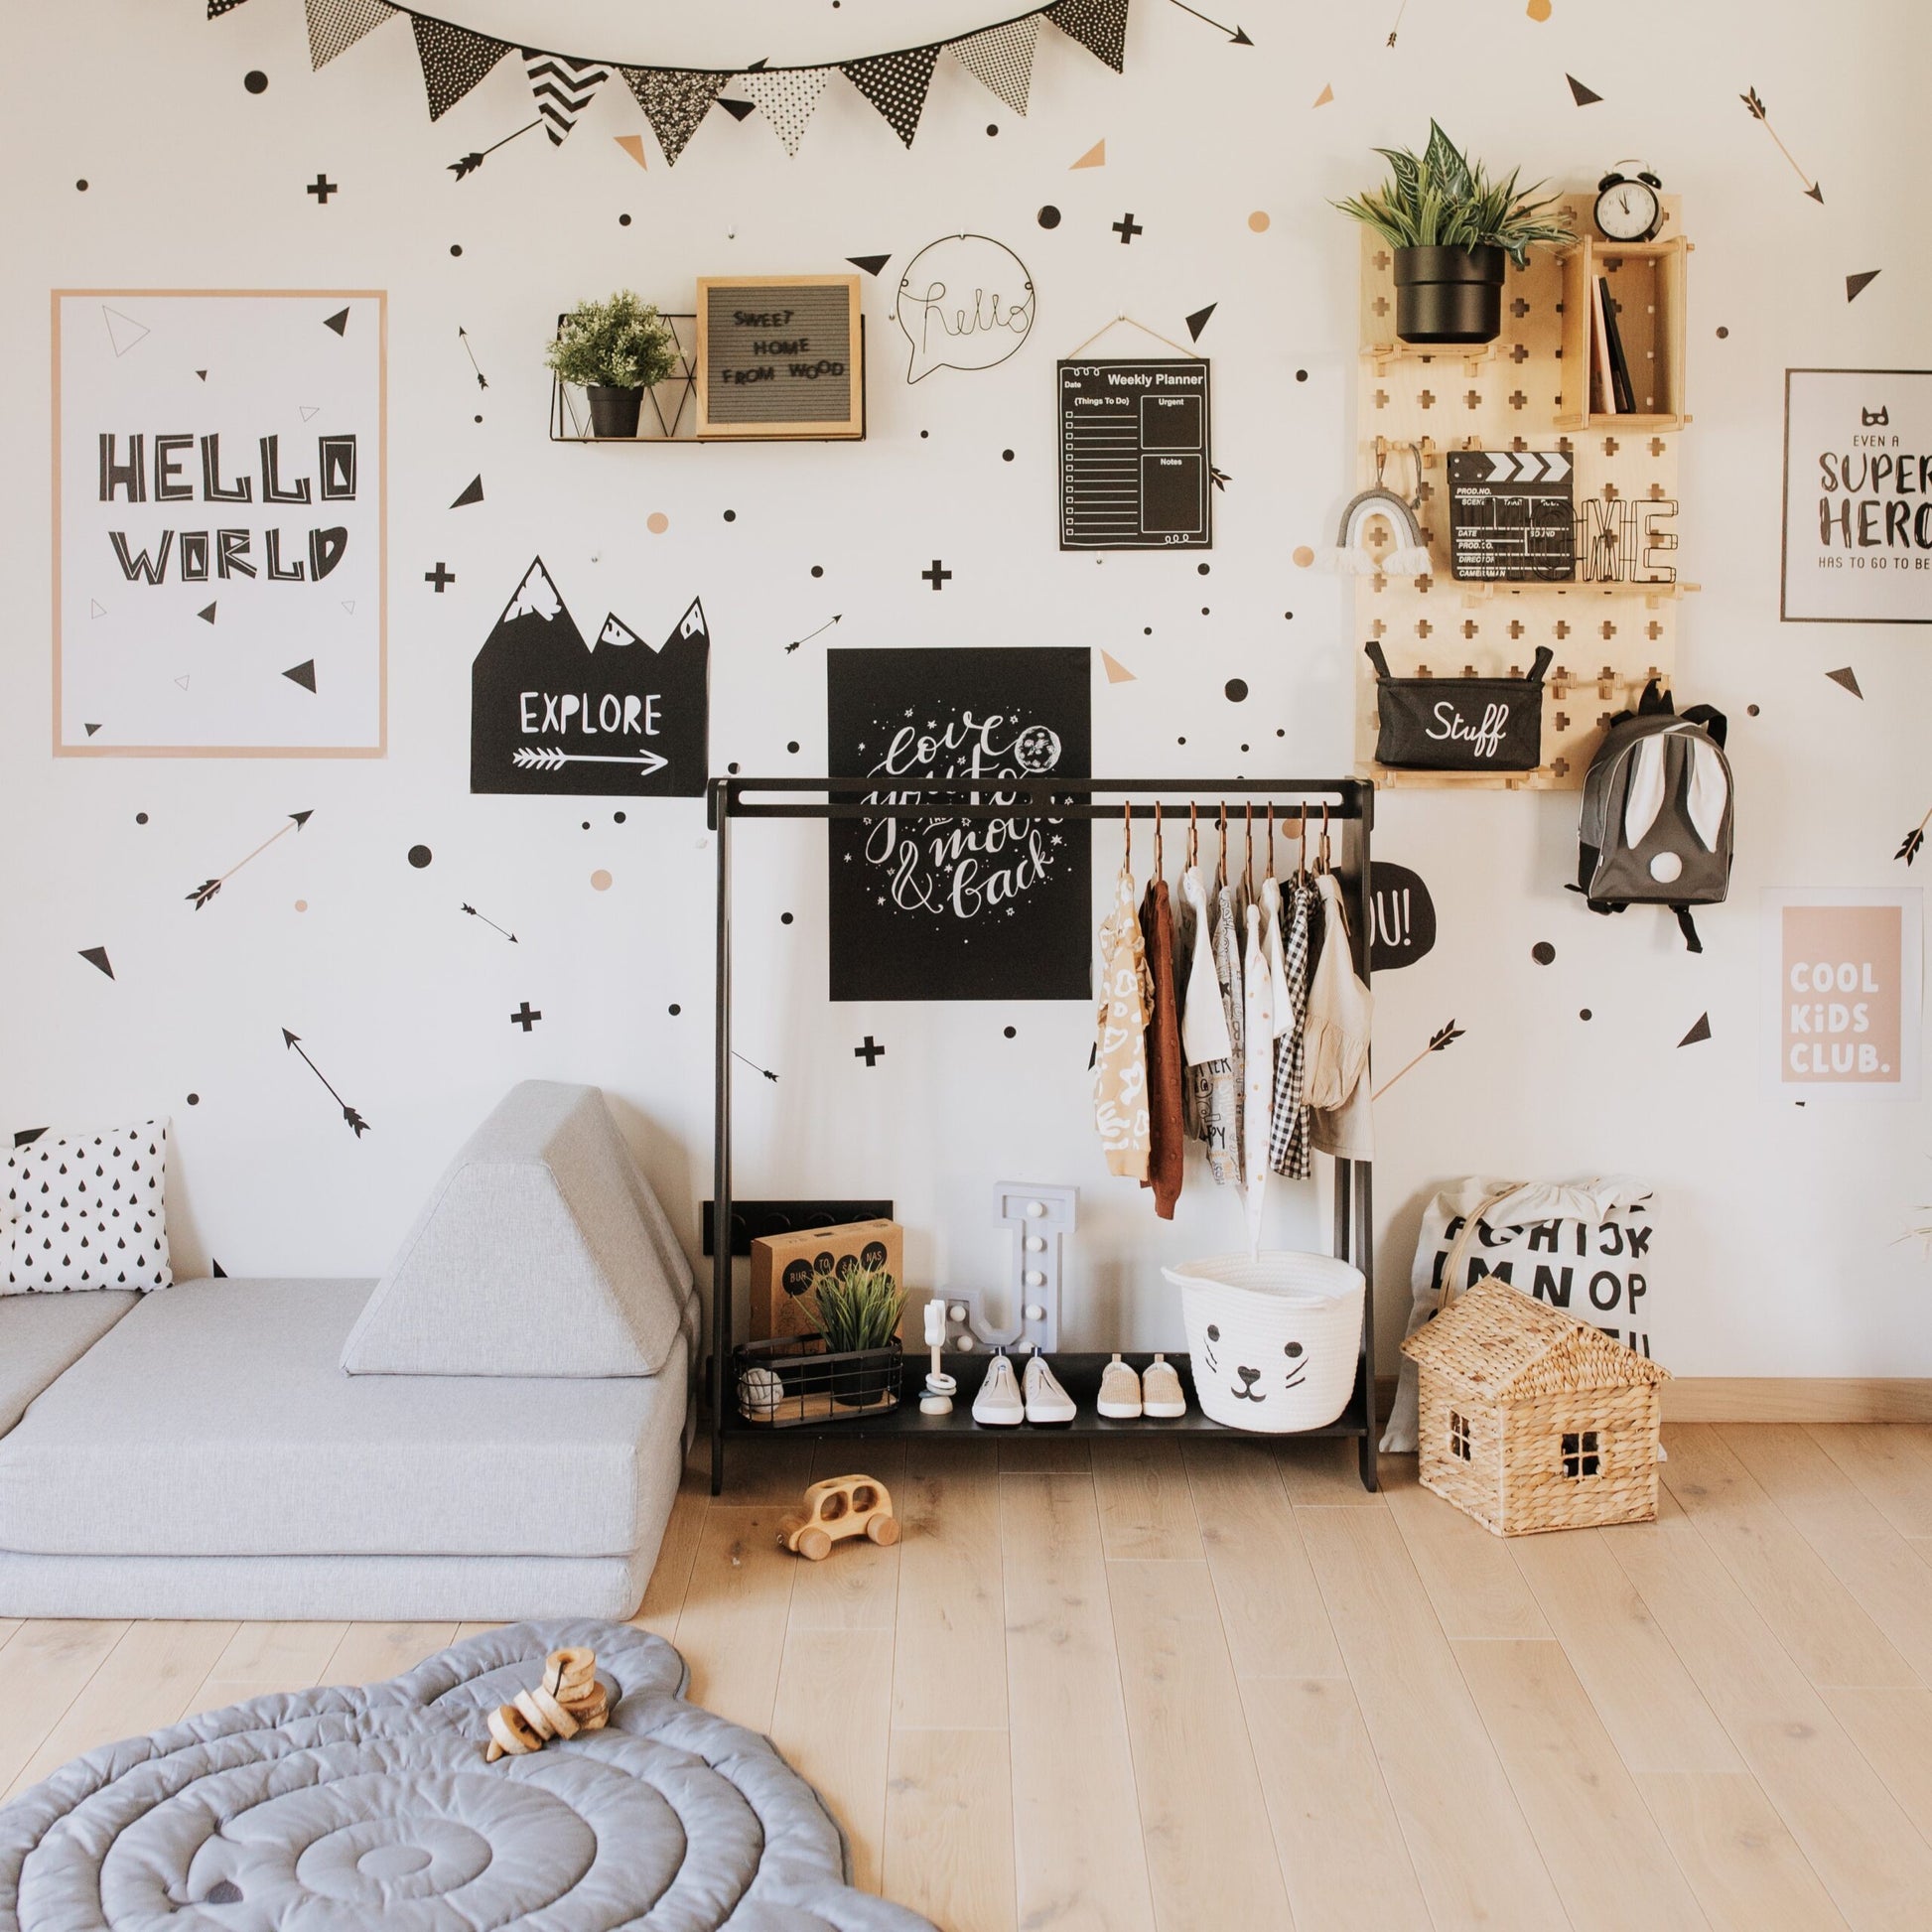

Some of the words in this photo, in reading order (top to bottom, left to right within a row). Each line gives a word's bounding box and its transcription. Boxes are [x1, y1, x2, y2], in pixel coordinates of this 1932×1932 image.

[733, 310, 794, 328] SWEET
[899, 281, 1035, 354] hello
[753, 338, 811, 355] HOME
[722, 367, 775, 385] FROM
[788, 359, 844, 380] WOOD
[1108, 373, 1152, 388] Weekly
[1156, 373, 1203, 385] Planner
[1159, 398, 1184, 407] Urgent
[1853, 435, 1885, 447] EVEN
[1891, 435, 1899, 447] A
[99, 433, 356, 505] HELLO
[1819, 496, 1932, 550] HERO
[108, 526, 348, 585] WORLD
[1819, 556, 1843, 569] HAS
[1850, 557, 1864, 569] TO
[1870, 557, 1887, 569] GO
[1893, 558, 1909, 569] TO
[520, 691, 662, 736] EXPLORE
[1425, 701, 1509, 758] Stuff
[866, 711, 1017, 778] love
[928, 796, 1063, 867] moo
[892, 840, 943, 913] &
[947, 829, 1054, 918] back
[1370, 888, 1411, 947] U!
[1790, 962, 1879, 993] COOL
[1790, 1043, 1890, 1073] CLUB.
